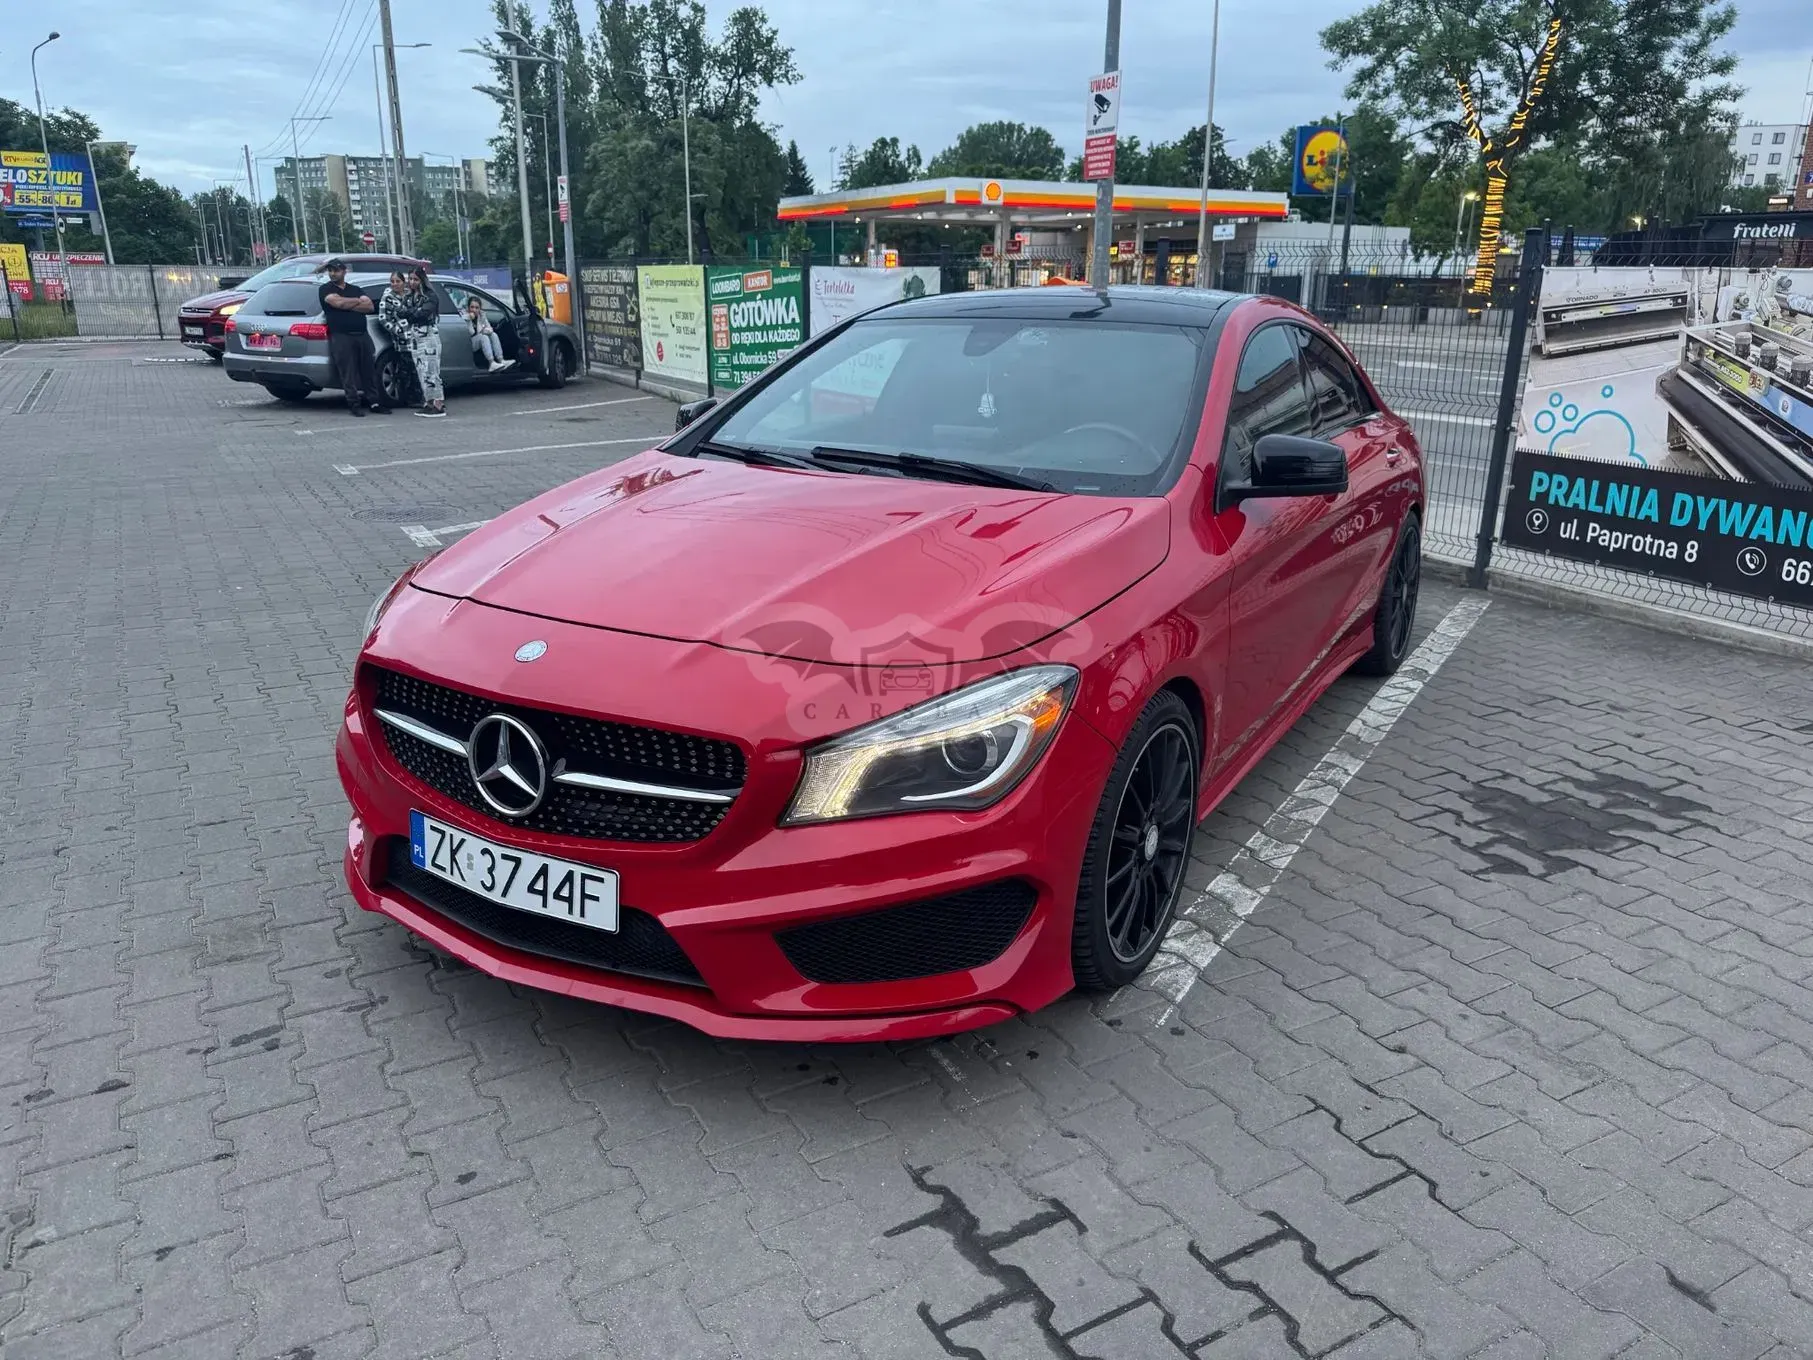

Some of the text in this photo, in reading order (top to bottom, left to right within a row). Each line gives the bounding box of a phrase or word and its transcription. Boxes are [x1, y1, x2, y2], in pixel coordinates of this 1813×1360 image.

[1090, 75, 1118, 93] UWAGA!
[1733, 222, 1797, 239] fratelli
[712, 279, 740, 294] LOOMBARD
[730, 293, 800, 328] GOTÓWKA
[732, 332, 740, 345] OD
[755, 331, 768, 343] DLA
[768, 326, 800, 343] KAŻDEGO
[739, 352, 767, 365] Obornicka
[1528, 470, 1813, 550] PRALNIA DYWAN
[1560, 518, 1699, 563] ul. Paprotna 8
[1781, 557, 1813, 586] 66
[413, 843, 424, 859] PL
[429, 824, 605, 919] ZK 3744F
